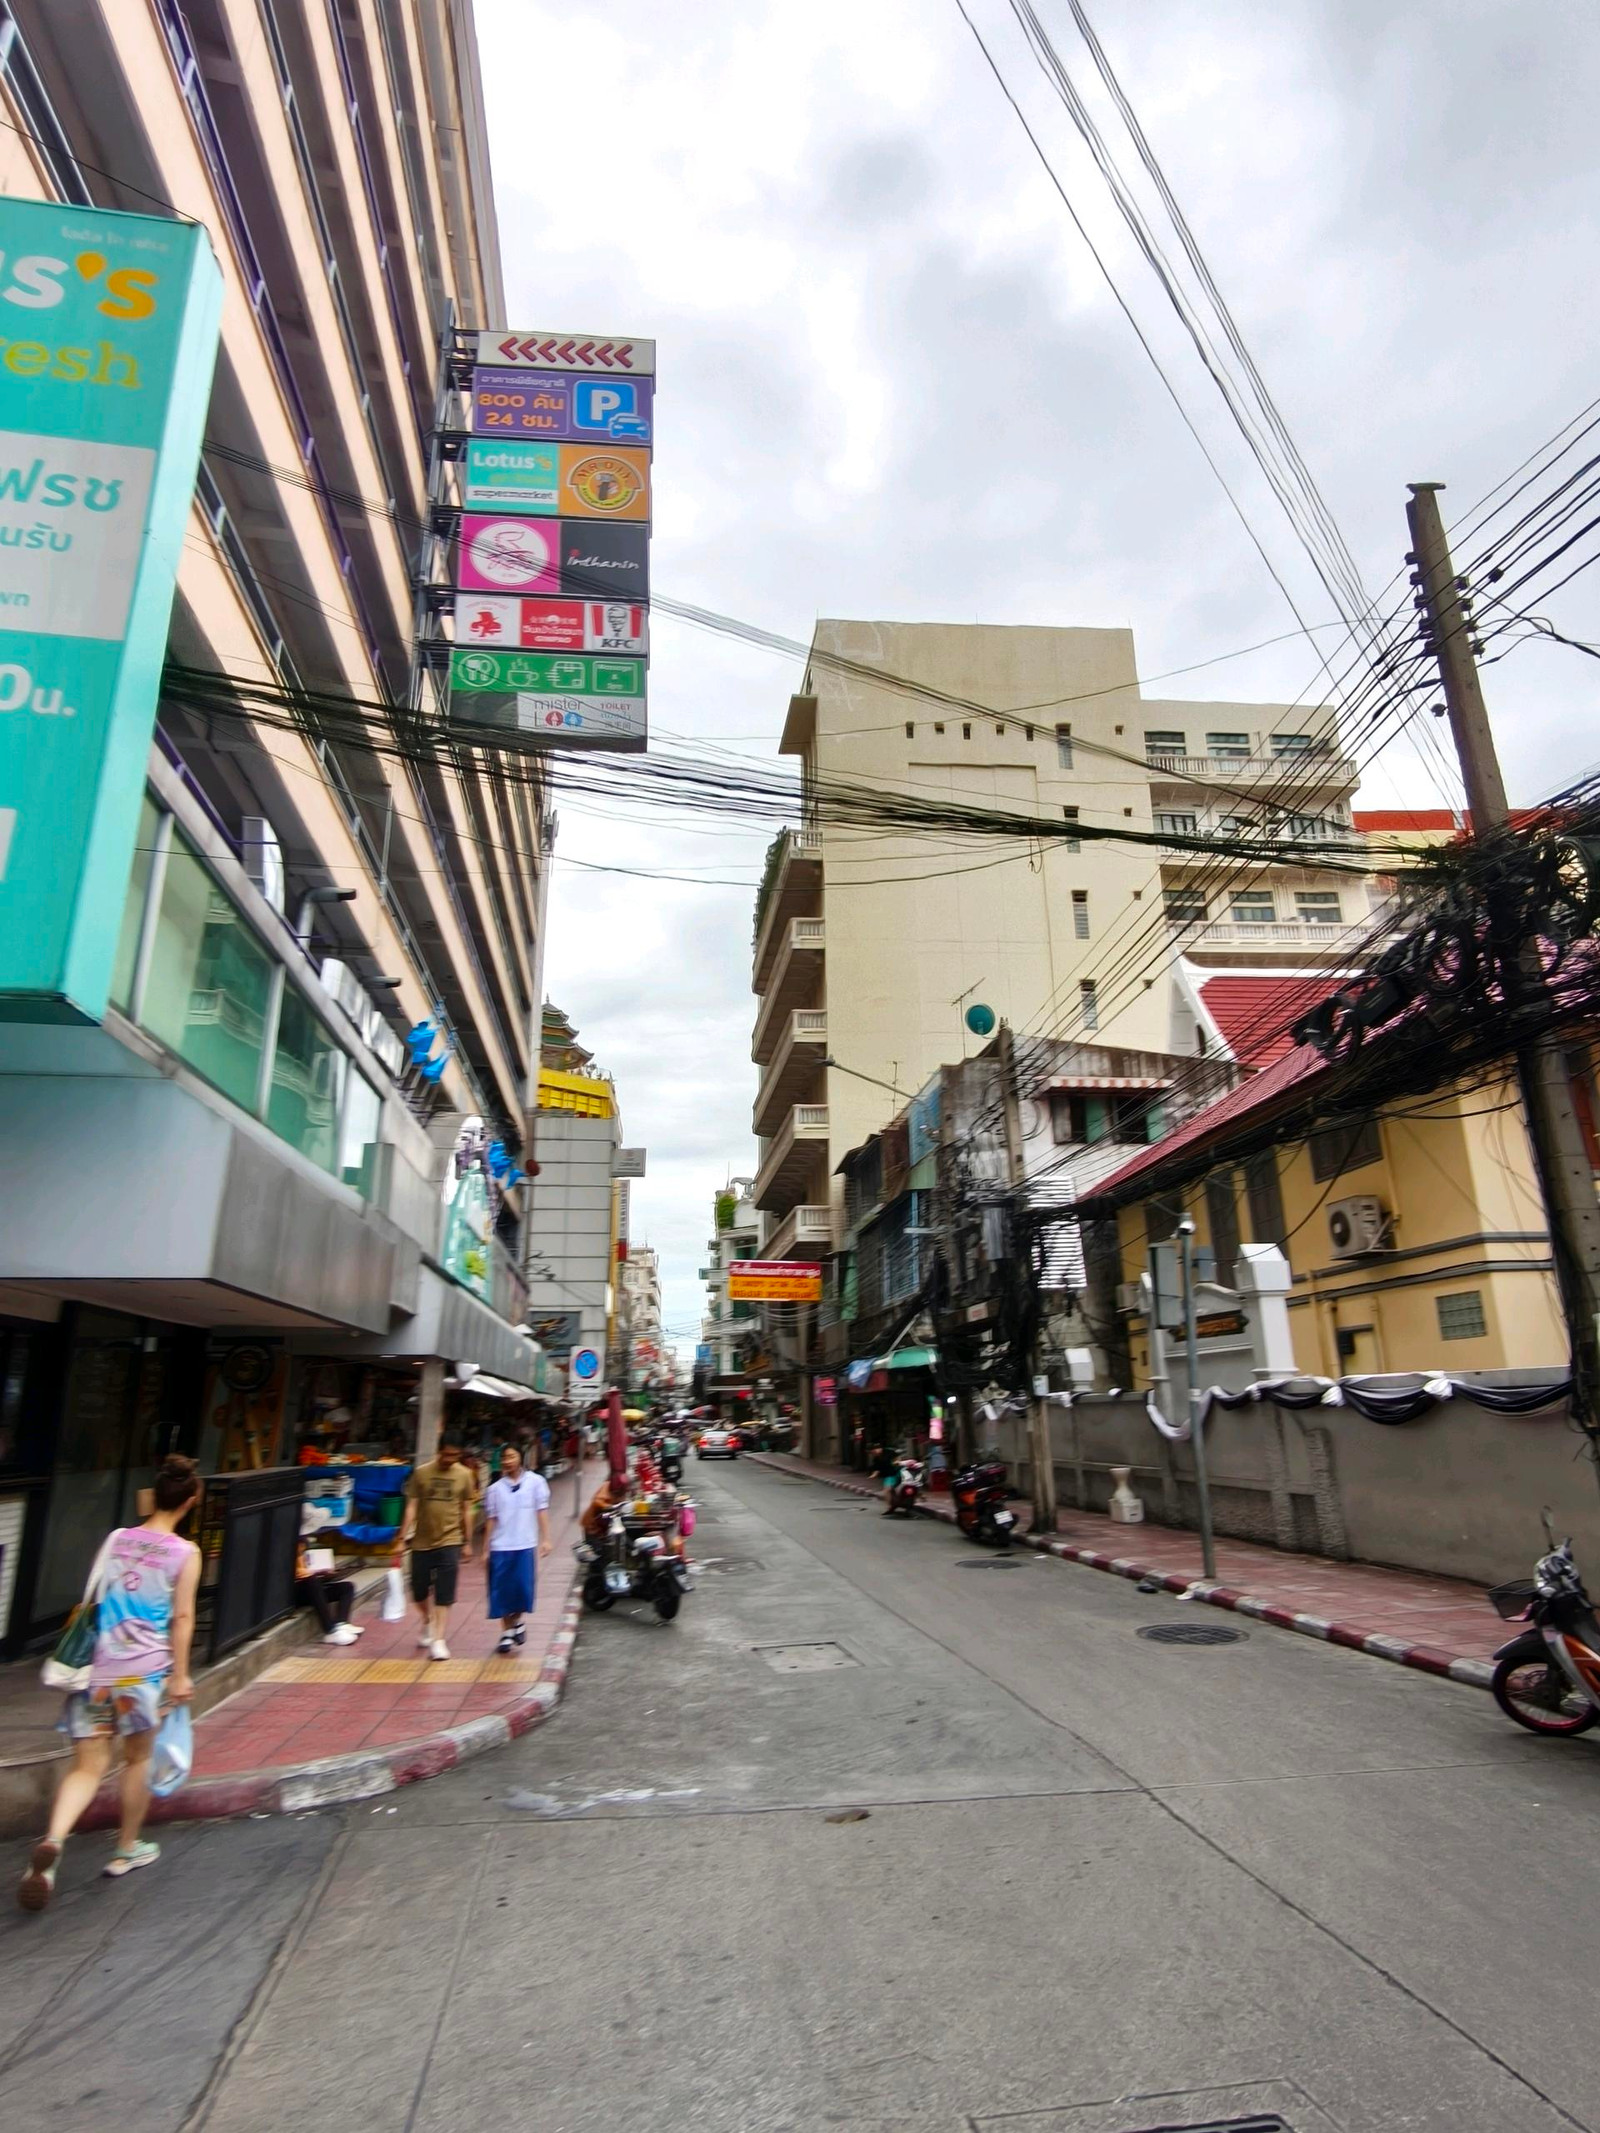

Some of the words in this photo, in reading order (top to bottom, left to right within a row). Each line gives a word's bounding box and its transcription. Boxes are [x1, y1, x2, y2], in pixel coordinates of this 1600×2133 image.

[0, 250, 160, 321] s's
[0, 337, 142, 389] esh
[479, 393, 526, 408] 800
[533, 392, 565, 410] คัน
[590, 389, 622, 422] P
[485, 411, 514, 426] 24
[522, 414, 559, 429] ชม.
[600, 638, 635, 650] KFC
[534, 697, 581, 711] mister
